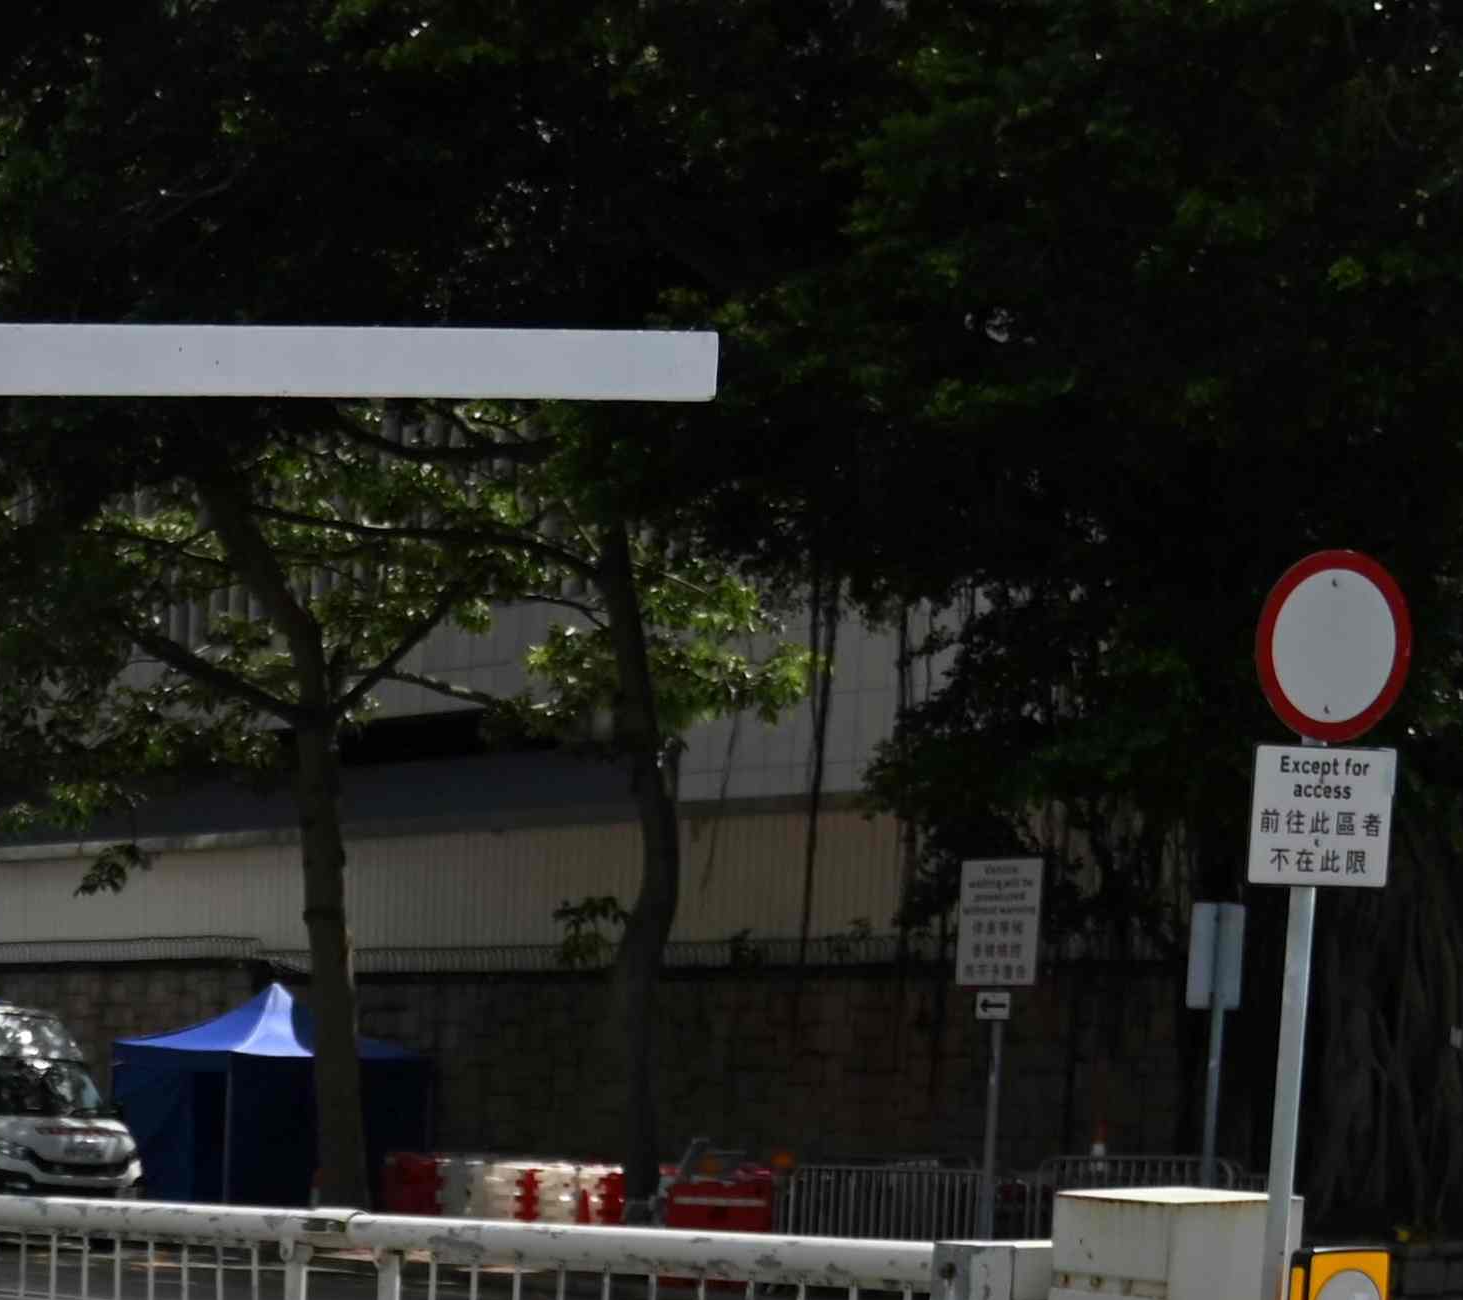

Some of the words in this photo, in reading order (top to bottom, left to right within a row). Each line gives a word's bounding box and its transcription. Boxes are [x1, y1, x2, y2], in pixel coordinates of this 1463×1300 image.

[1280, 756, 1339, 781] Except
[1345, 758, 1370, 777] for
[1293, 784, 1352, 800] access
[1259, 808, 1382, 838] 前往此區者
[1269, 848, 1366, 875] 不在此限
